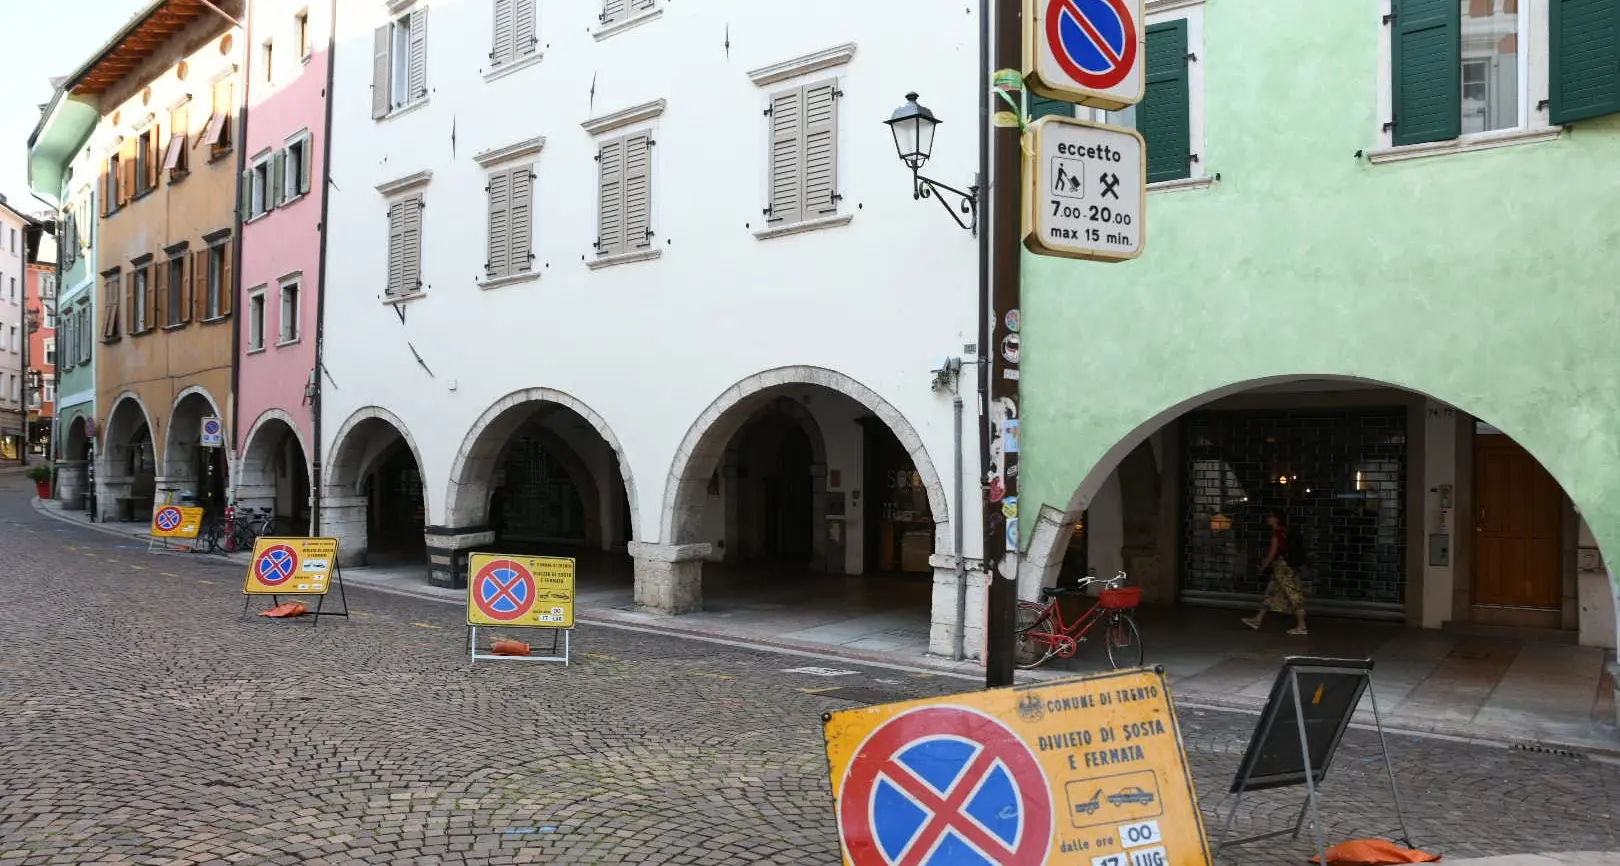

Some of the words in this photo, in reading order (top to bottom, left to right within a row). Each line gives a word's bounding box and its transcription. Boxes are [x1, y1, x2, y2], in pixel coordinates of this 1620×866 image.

[1057, 142, 1121, 163] eccetto
[1051, 227, 1078, 240] max
[1085, 228, 1099, 242] 15
[1106, 232, 1133, 246] min.
[1047, 694, 1096, 713] COMUNE
[1099, 691, 1112, 705] DI
[1116, 686, 1158, 704] TRENTO
[1038, 730, 1092, 751] DIVIETO
[1099, 727, 1115, 743] DI
[1122, 719, 1166, 741] SOSTA
[1067, 754, 1078, 770] E
[1084, 745, 1145, 768] FERMATA
[1060, 837, 1090, 853] dalle
[1096, 836, 1114, 848] ore
[1128, 824, 1152, 842] 00
